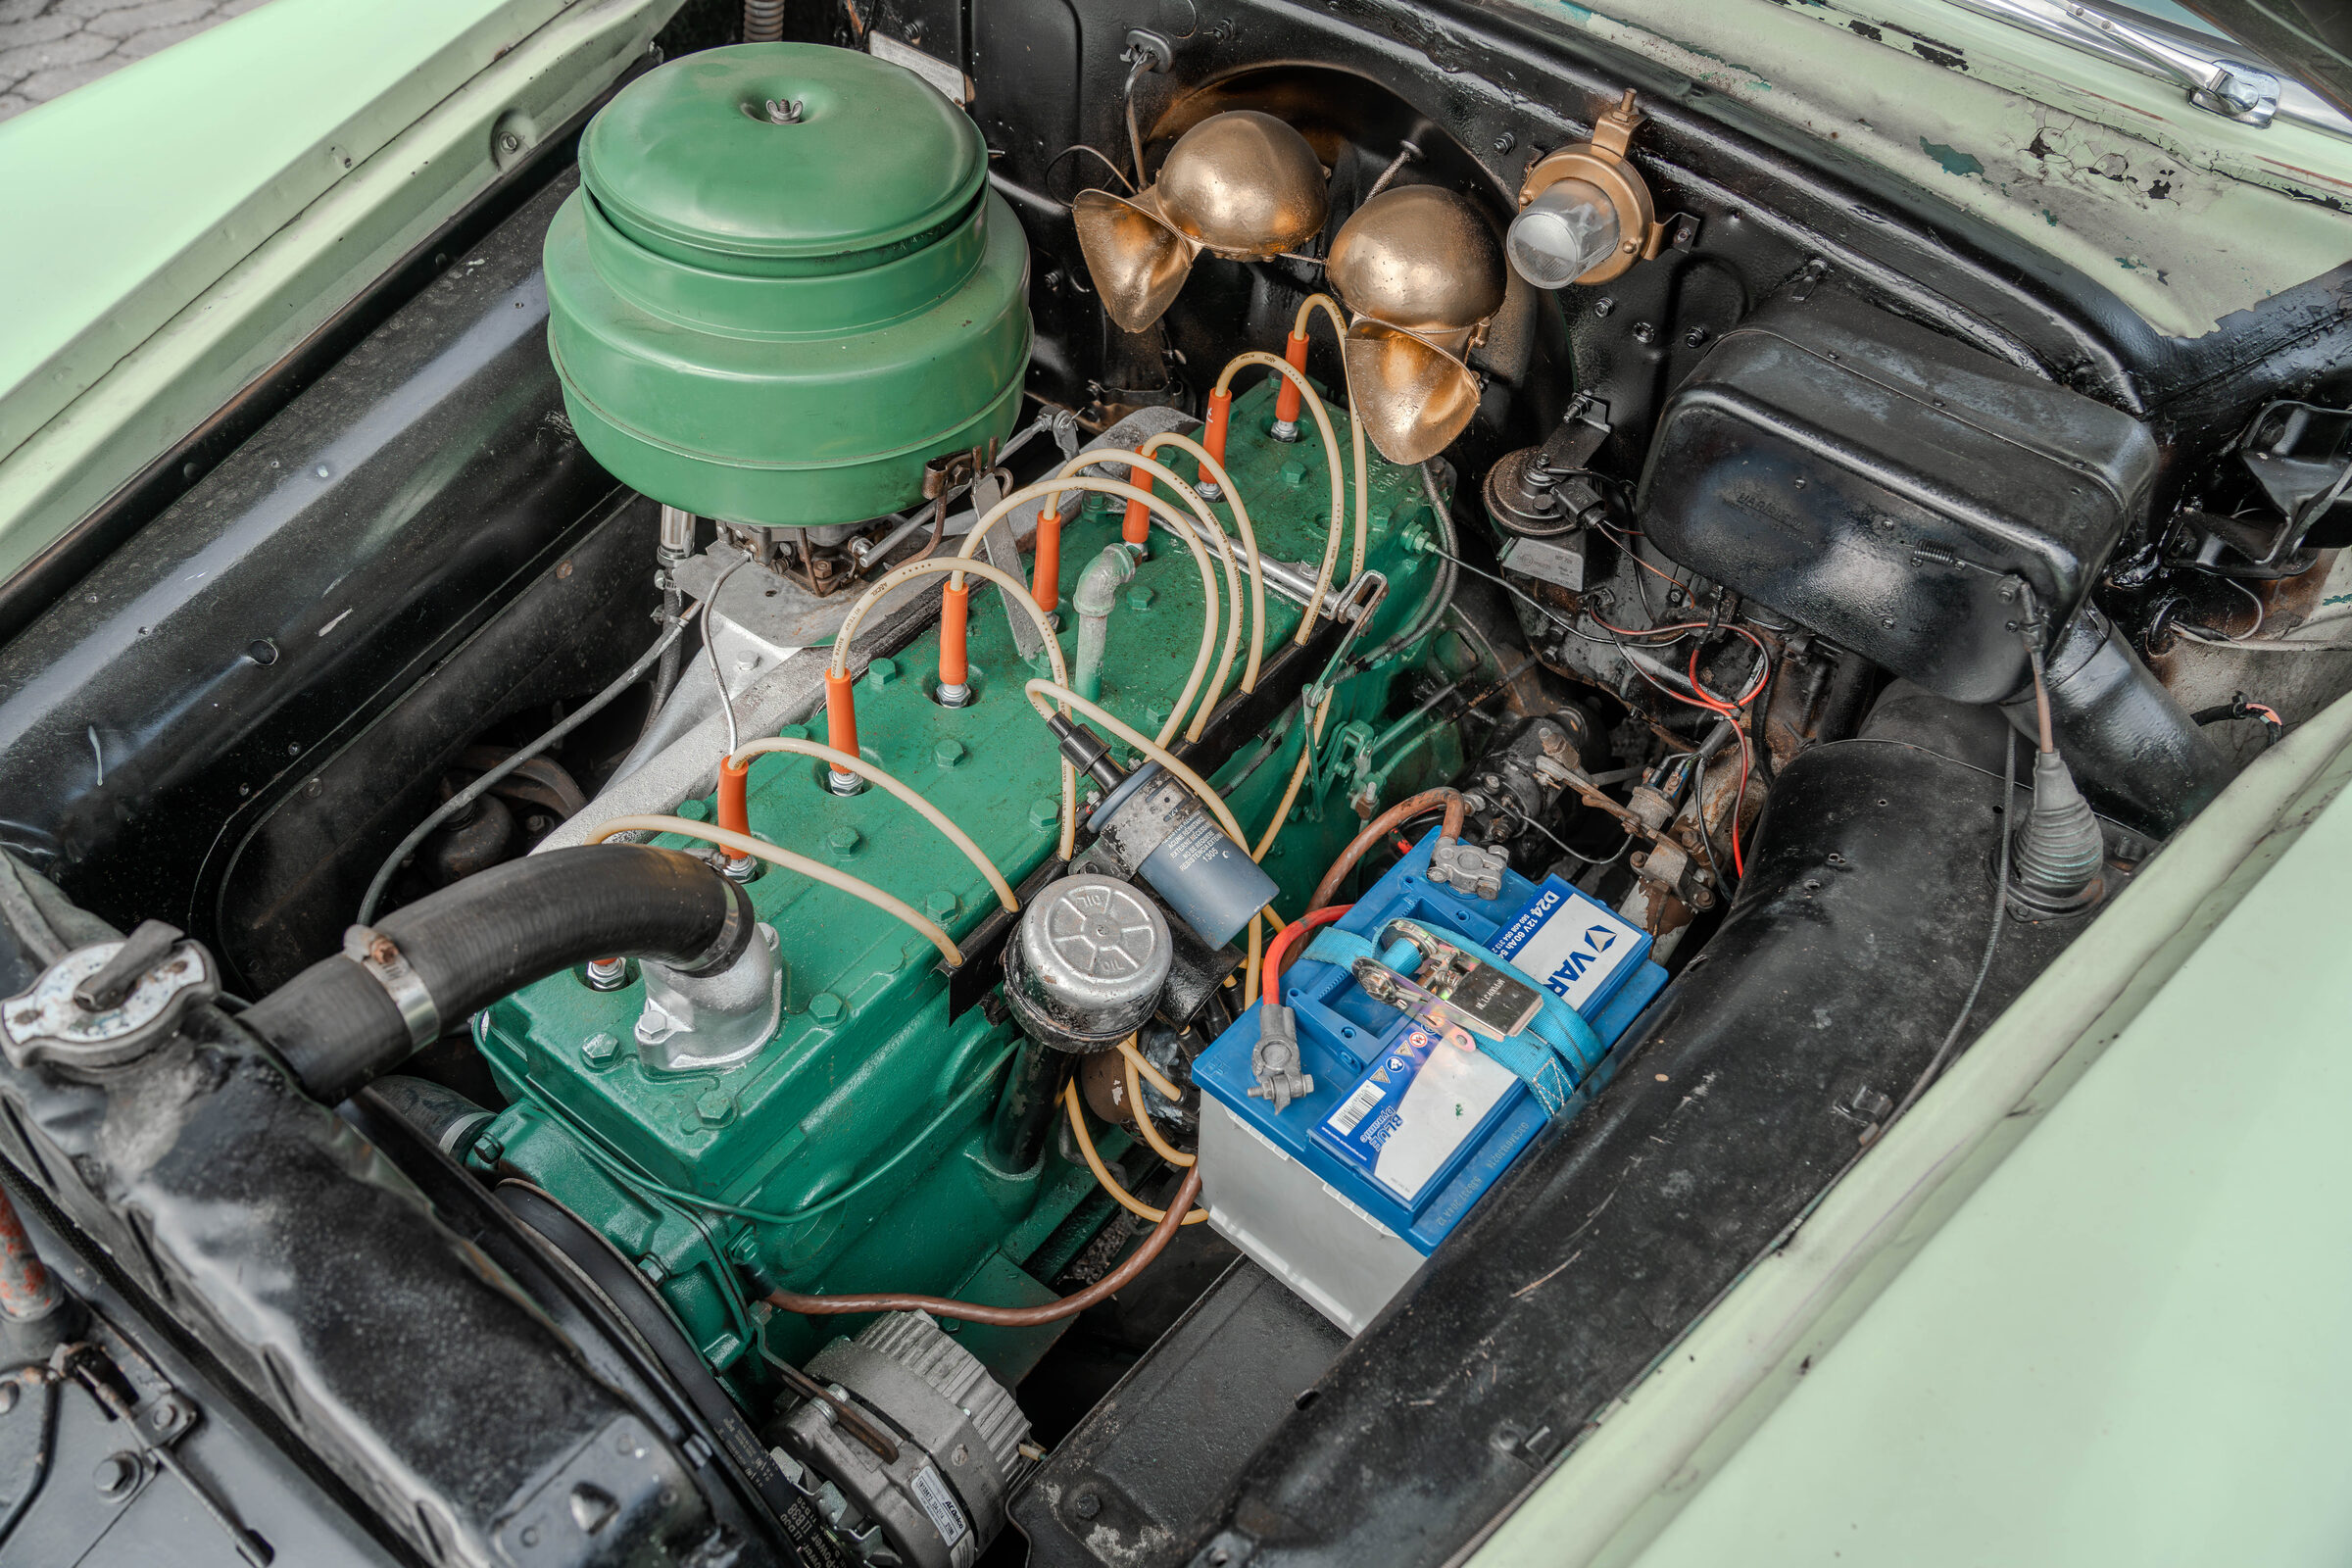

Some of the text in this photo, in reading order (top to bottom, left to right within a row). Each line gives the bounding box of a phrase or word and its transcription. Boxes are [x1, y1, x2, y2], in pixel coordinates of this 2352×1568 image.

[1181, 850, 1191, 858] NO
[1200, 846, 1219, 862] 1305
[1076, 893, 1103, 908] OIL
[1533, 889, 1560, 921] D24
[1522, 915, 1538, 933] 12V
[1101, 958, 1126, 972] OIL
[1543, 951, 1596, 998] VAR
[1357, 1102, 1396, 1147] Dynamic
[1366, 1109, 1405, 1153] BLUE
[943, 1498, 965, 1529] ACDelco
